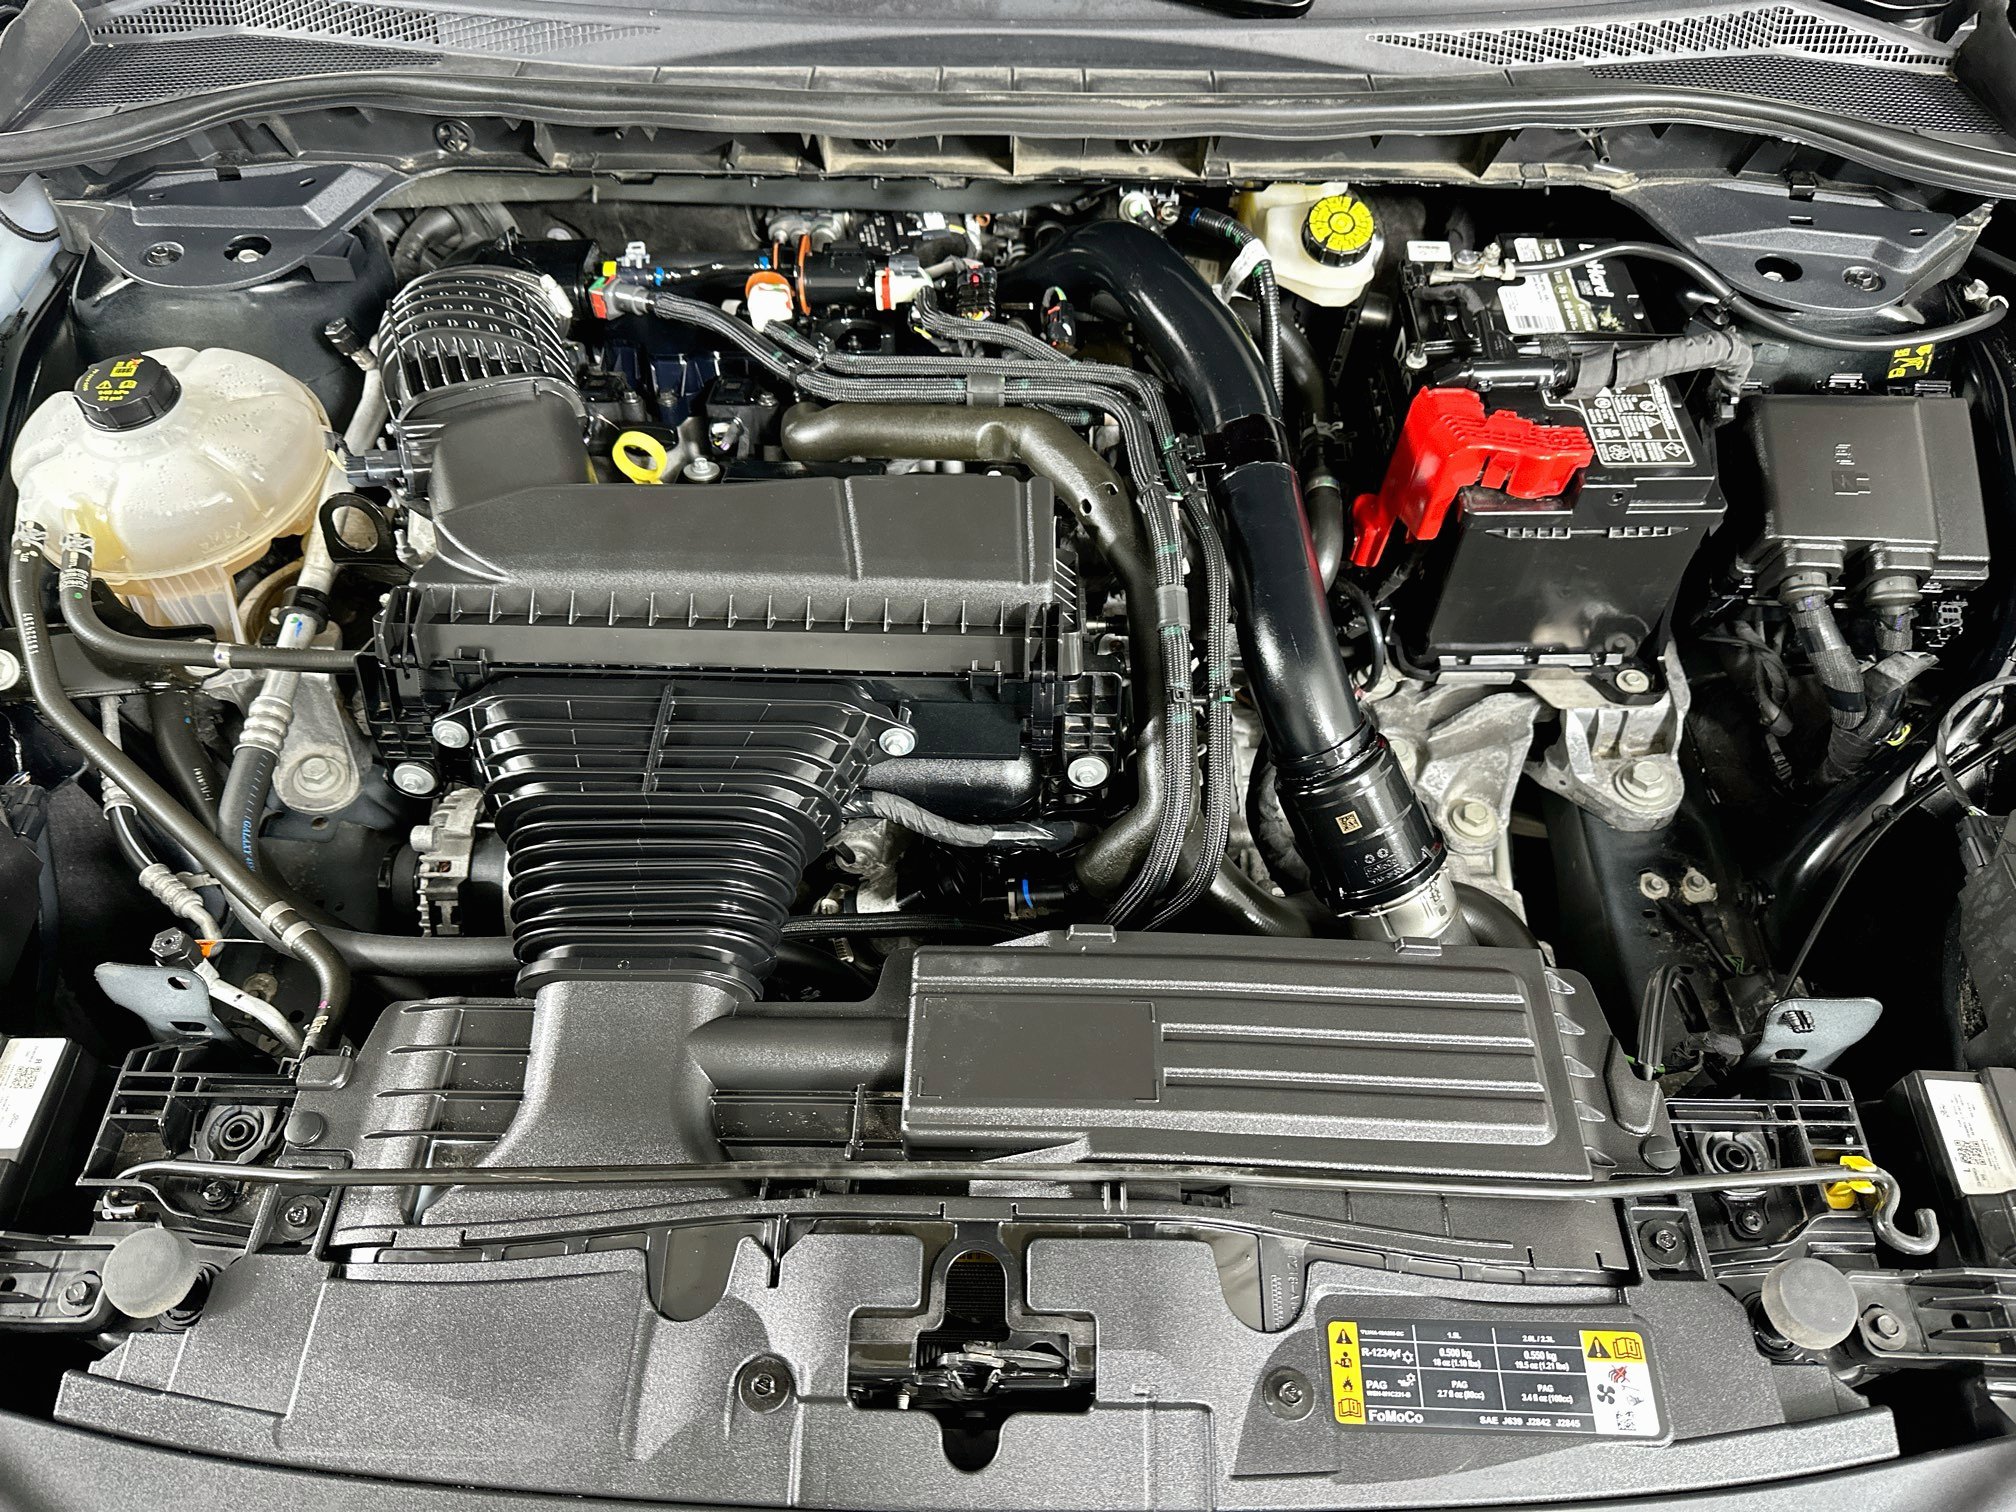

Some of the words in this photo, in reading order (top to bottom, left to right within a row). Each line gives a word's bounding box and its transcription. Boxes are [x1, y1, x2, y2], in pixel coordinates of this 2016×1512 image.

[1578, 243, 1615, 298] Hard
[242, 820, 253, 856] GALAXY
[1361, 1347, 1401, 1360] R-1234yf
[1462, 1349, 1473, 1360] kg
[1523, 1350, 1545, 1361] 0.550
[1546, 1351, 1558, 1362] kg
[1467, 1360, 1482, 1370] lbs)
[1539, 1361, 1555, 1371] (1.21
[1555, 1362, 1570, 1372] lbs)
[1366, 1380, 1388, 1390] PAG
[1451, 1380, 1468, 1389] PAG
[1536, 1384, 1554, 1393] PAG
[1437, 1389, 1448, 1398] 2.7
[1368, 1409, 1424, 1423] FoMoCo
[1479, 1415, 1499, 1425] SAE
[1501, 1416, 1523, 1426] J639
[1525, 1418, 1552, 1428] J2842
[1555, 1419, 1581, 1428] J2845
